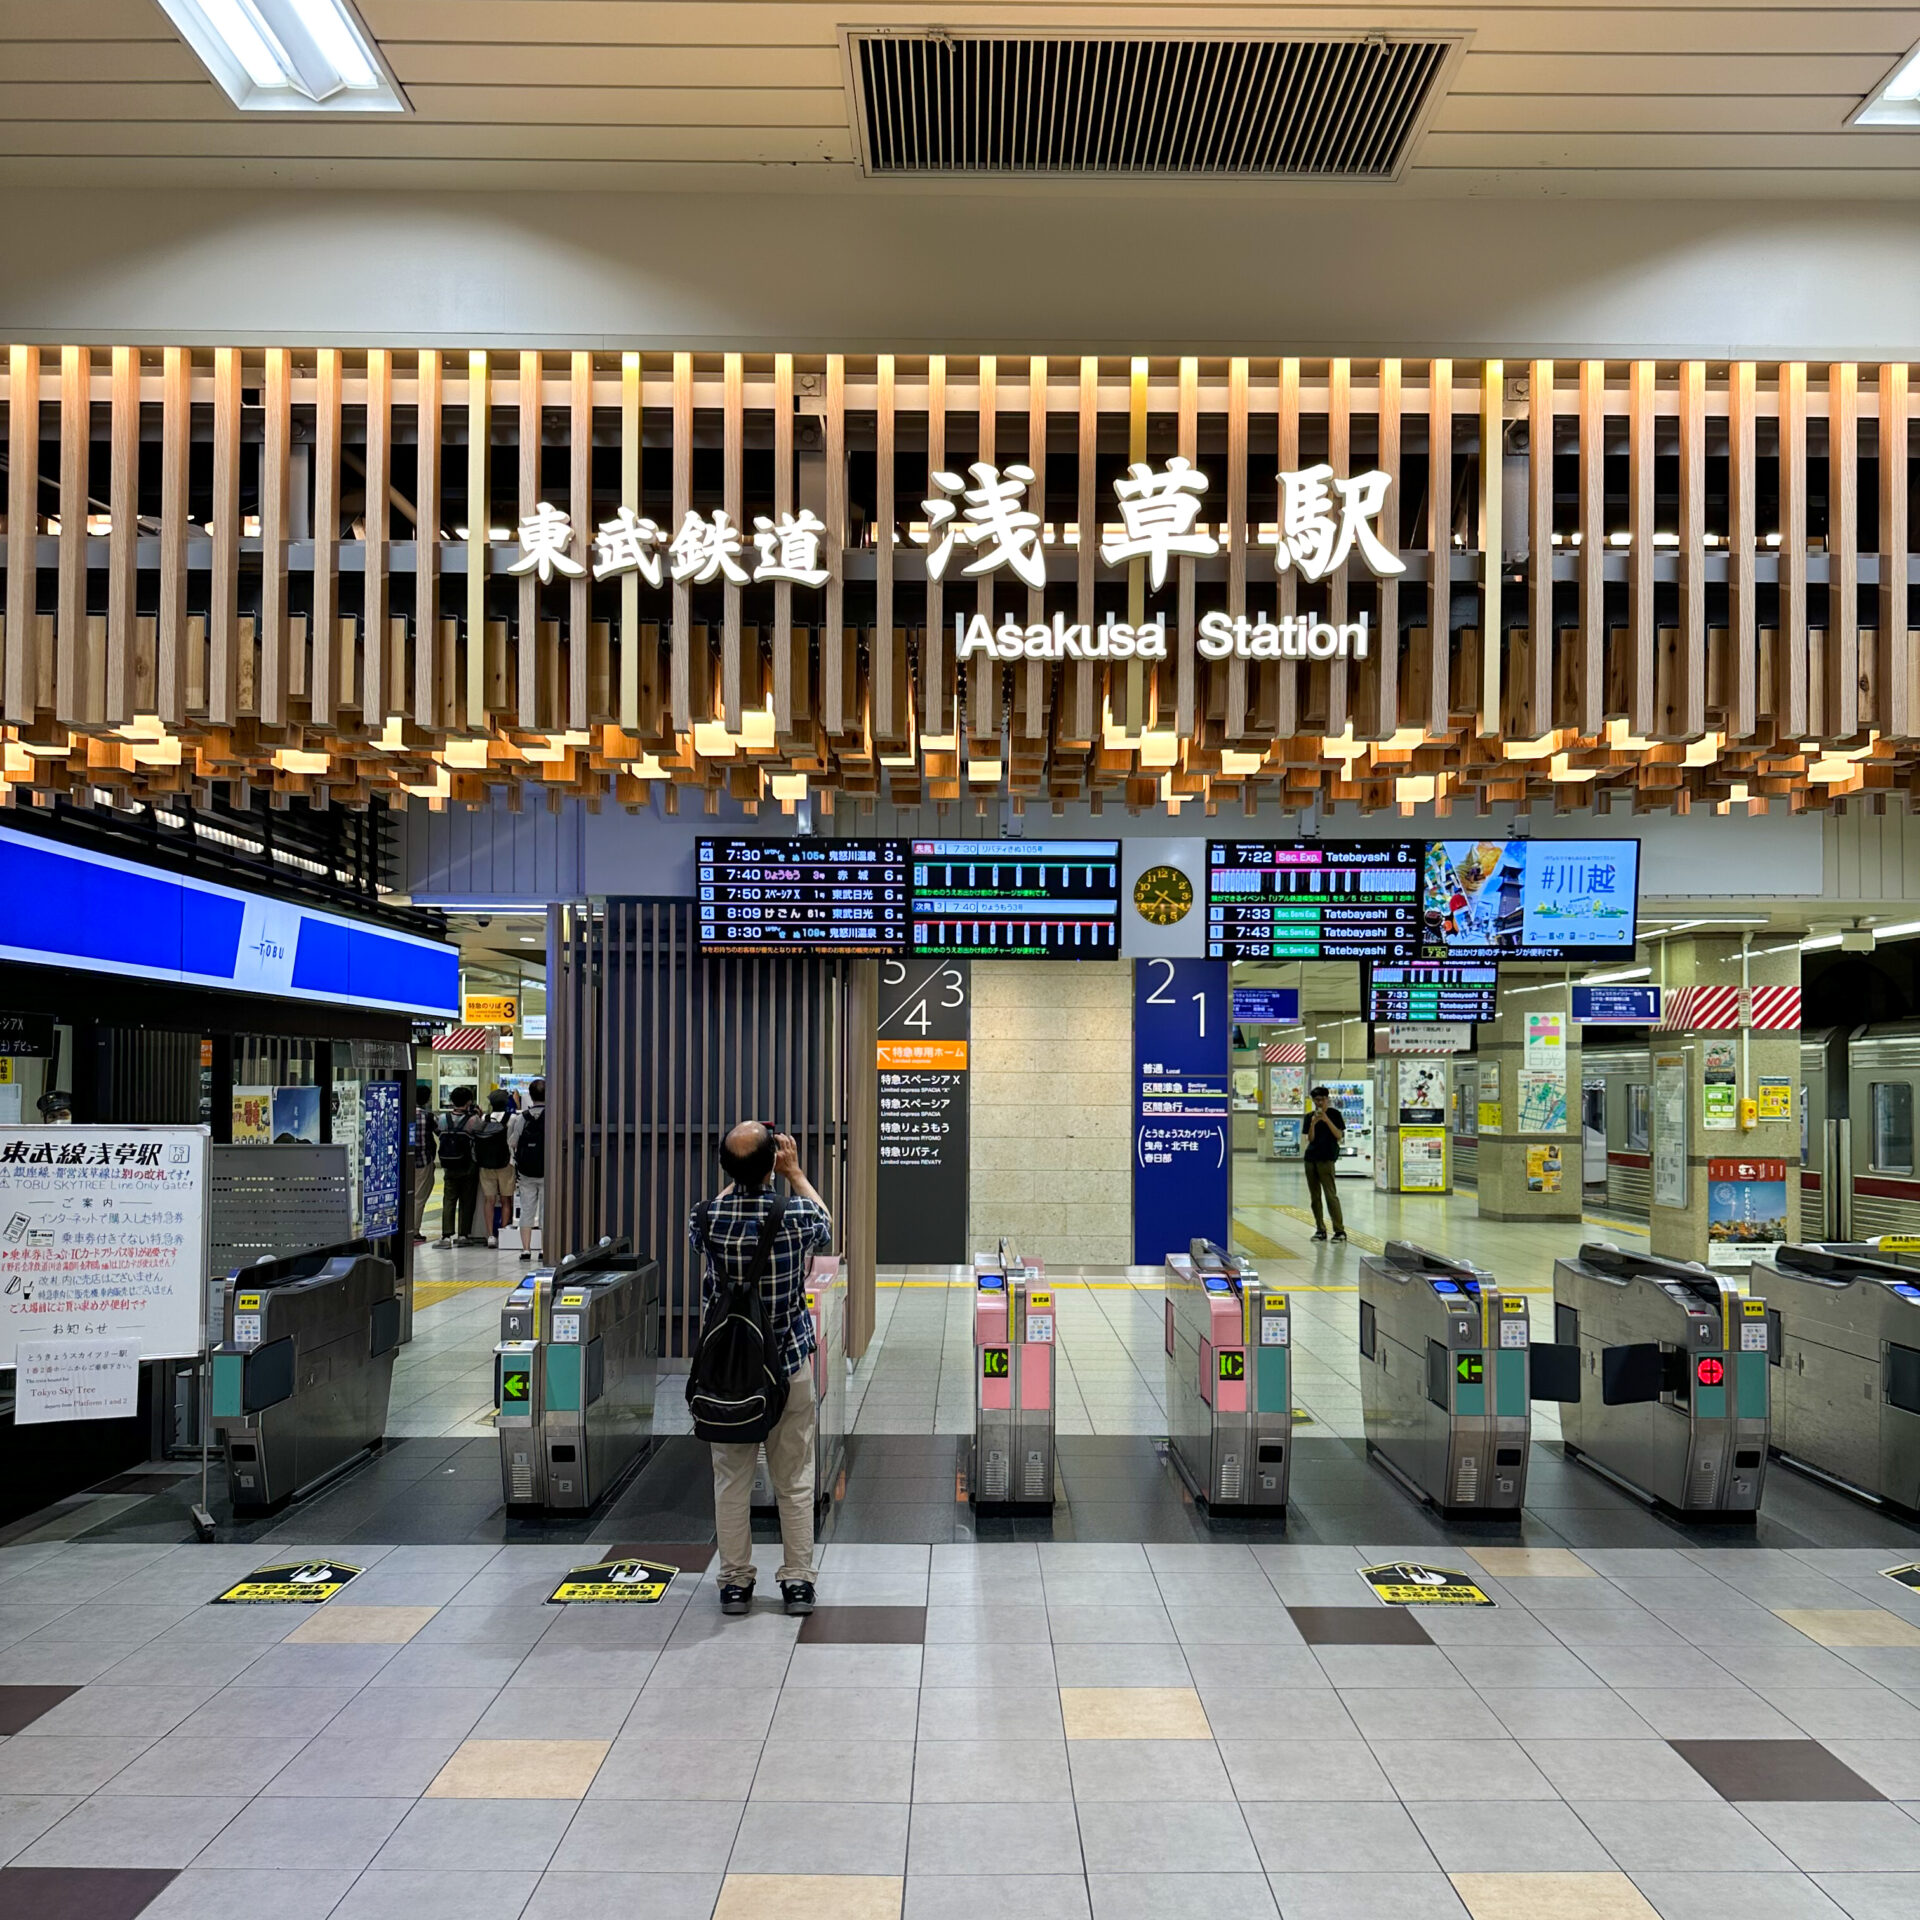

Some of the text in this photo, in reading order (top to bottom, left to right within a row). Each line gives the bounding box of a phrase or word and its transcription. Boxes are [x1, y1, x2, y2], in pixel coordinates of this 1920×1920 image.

[508, 459, 1408, 592] 東武鉄道 浅草駅
[957, 613, 1369, 662] Asakusa Station
[726, 850, 760, 861] 7:30
[829, 850, 877, 862] 鬼怒川温泉
[884, 851, 894, 861] 3
[1238, 851, 1272, 863] 7:22
[1300, 853, 1319, 863] Exp.
[1326, 852, 1390, 863] Tatebayashi
[1397, 851, 1407, 862] 6
[703, 869, 894, 881] 3 7:40 りょうもう 赤城 6
[1541, 864, 1616, 893] #川越
[727, 888, 761, 900] 7:50
[832, 889, 873, 900] 東武日光
[884, 889, 894, 900] 6
[915, 902, 933, 911] 次発
[704, 908, 894, 920] 4 8:09 けごん 東武日光 6
[1237, 908, 1271, 919] 7:33
[1324, 909, 1388, 920] Tatebayashi
[1395, 909, 1405, 920] 6
[704, 927, 894, 939] 4 8:30 鬼怒川温泉 3
[1236, 926, 1270, 938] 7:43
[1324, 927, 1387, 938] Tatebayashi
[1394, 927, 1405, 938] 8
[260, 942, 284, 959] TOBU
[1236, 944, 1270, 956] 7:52
[1323, 945, 1387, 956] Tatebayashi
[1394, 945, 1404, 956] 6
[1448, 948, 1564, 957] お出かけ前のチャージが便利です。
[1146, 958, 1176, 1004] 2
[940, 970, 964, 1007] 3
[1387, 991, 1409, 999] 7:33
[1439, 1002, 1477, 1010] Tatebayashi
[1646, 991, 1655, 1013] 1
[503, 1002, 515, 1018] 3
[1192, 991, 1205, 1038] 1
[1386, 1012, 1407, 1020] 7:52
[903, 999, 932, 1036] 4
[892, 1046, 964, 1058] 特急専用ホーム
[880, 1074, 951, 1085] 特急スペーシア
[880, 1098, 951, 1109] 特急スペーシア
[1143, 1102, 1183, 1112] 区間急行
[880, 1122, 950, 1133] 特急りょうもう
[1144, 1129, 1218, 1138] とうきょうスカイツリー
[0, 1141, 163, 1166] 東武線浅草駅
[880, 1146, 939, 1157] 特急リバティ
[1144, 1153, 1173, 1163] 春日部
[15, 1180, 49, 1191] TOBU
[54, 1179, 108, 1190] SKYTREE
[135, 1180, 160, 1191] Only
[38, 1271, 163, 1286] 改札内に売店はございません
[53, 1322, 108, 1335] お知らせ
[28, 1350, 128, 1362] とうきょうスカイツリー駅
[984, 1352, 1008, 1373] IC
[1219, 1355, 1243, 1376] IC
[31, 1386, 96, 1398] Tokyo Sky Tree
